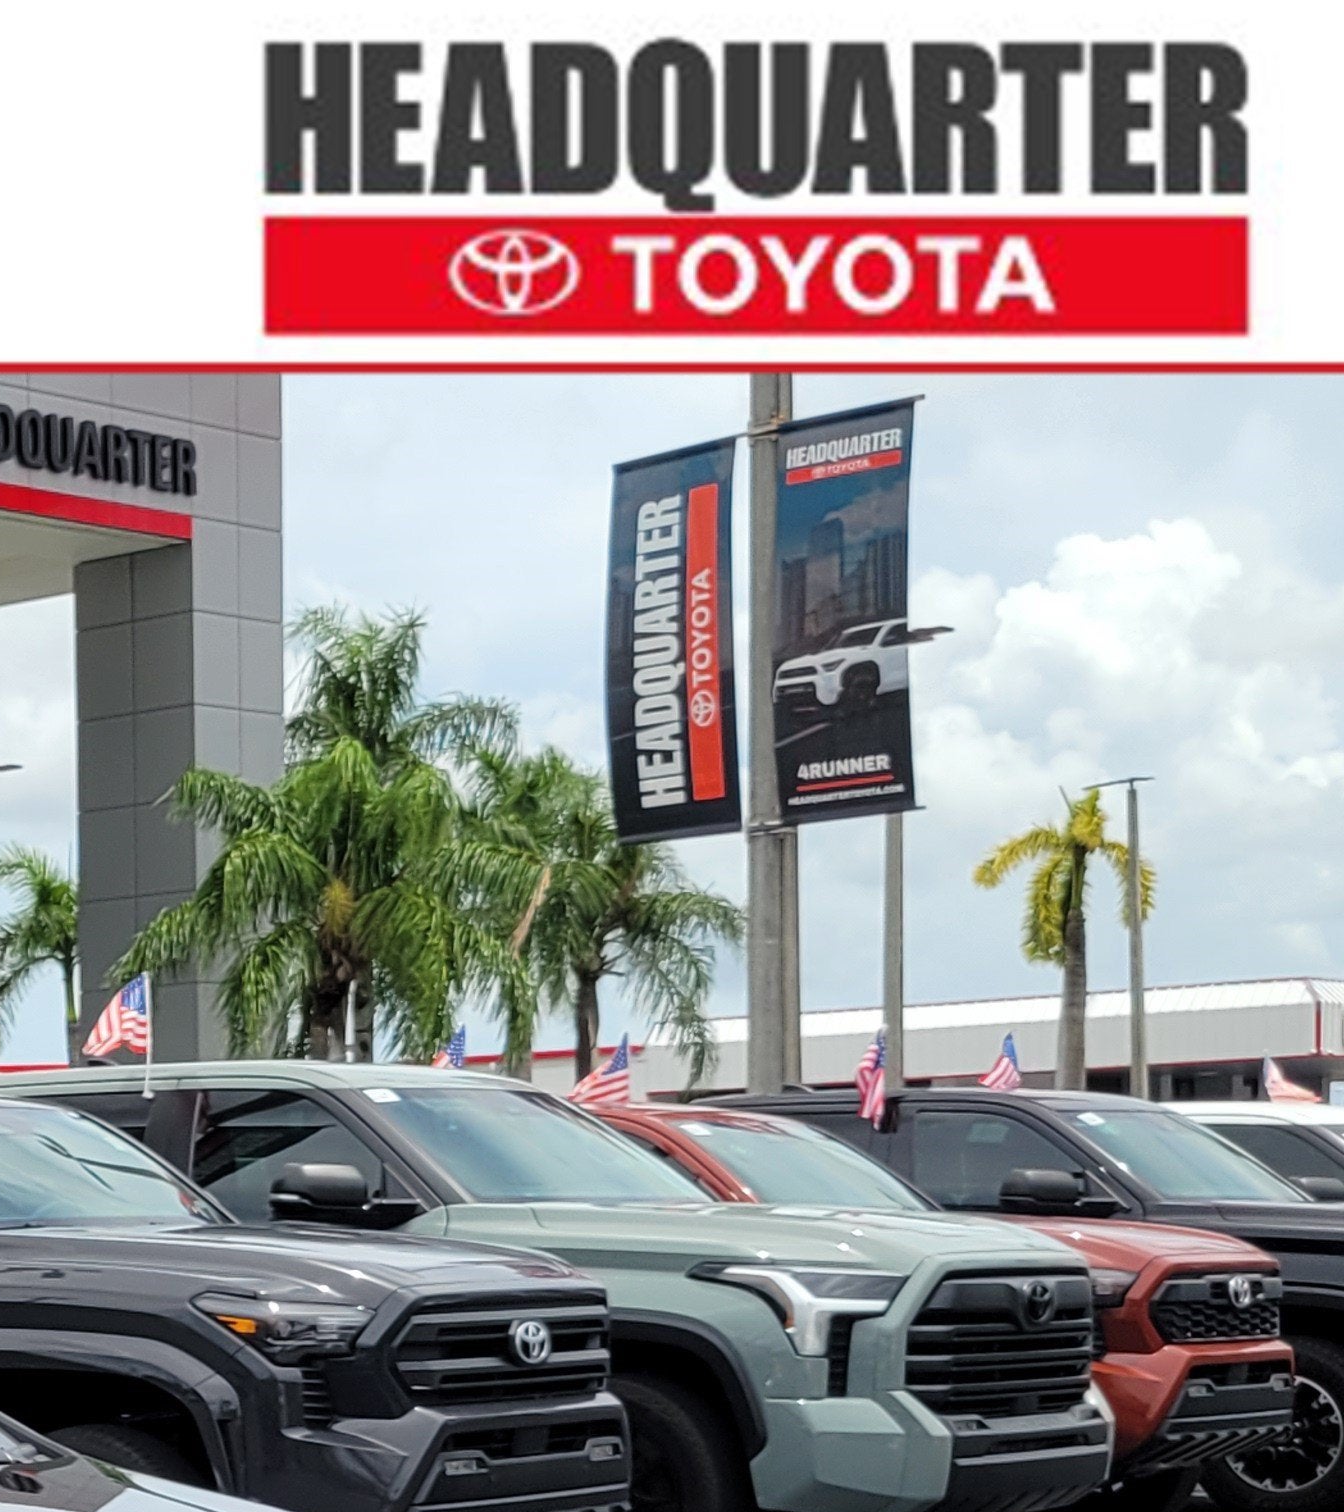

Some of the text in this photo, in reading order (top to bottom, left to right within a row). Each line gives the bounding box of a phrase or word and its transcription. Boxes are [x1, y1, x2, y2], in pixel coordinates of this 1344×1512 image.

[786, 428, 902, 470] HEADQUARTER
[633, 494, 687, 809] HEADQUARTER
[691, 567, 713, 688] TOYOTA
[797, 754, 891, 780] 4RUNNER
